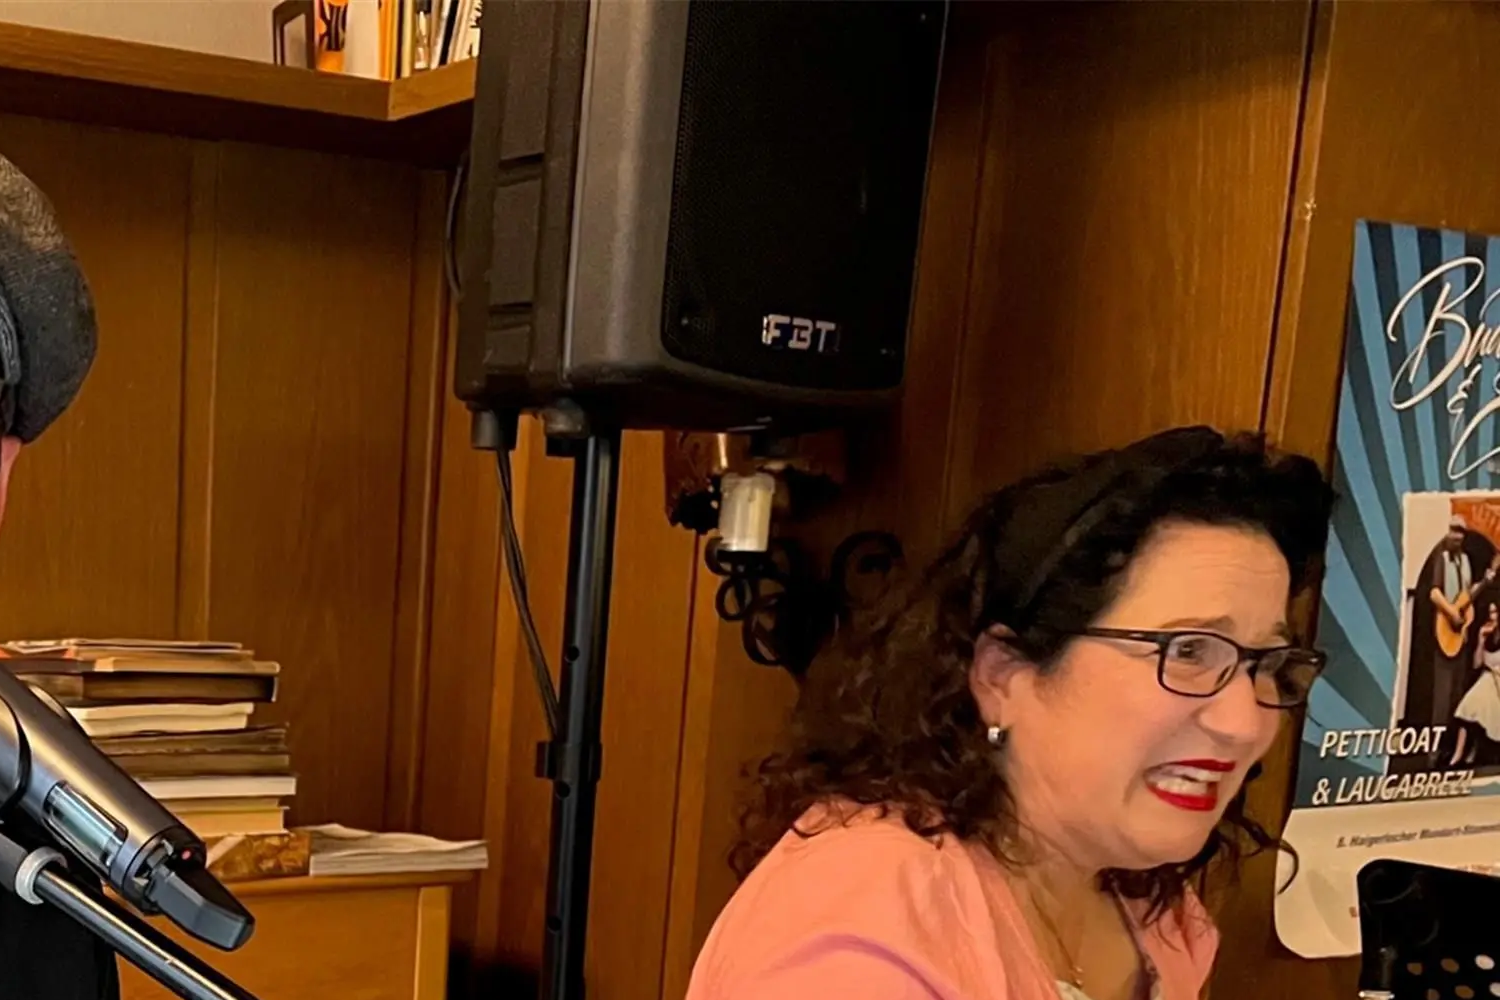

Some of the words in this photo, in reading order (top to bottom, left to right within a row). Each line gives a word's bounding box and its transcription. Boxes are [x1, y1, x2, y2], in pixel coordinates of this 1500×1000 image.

[762, 313, 837, 353] FBT
[1319, 726, 1448, 758] PETTICOAT
[1311, 777, 1332, 806] &
